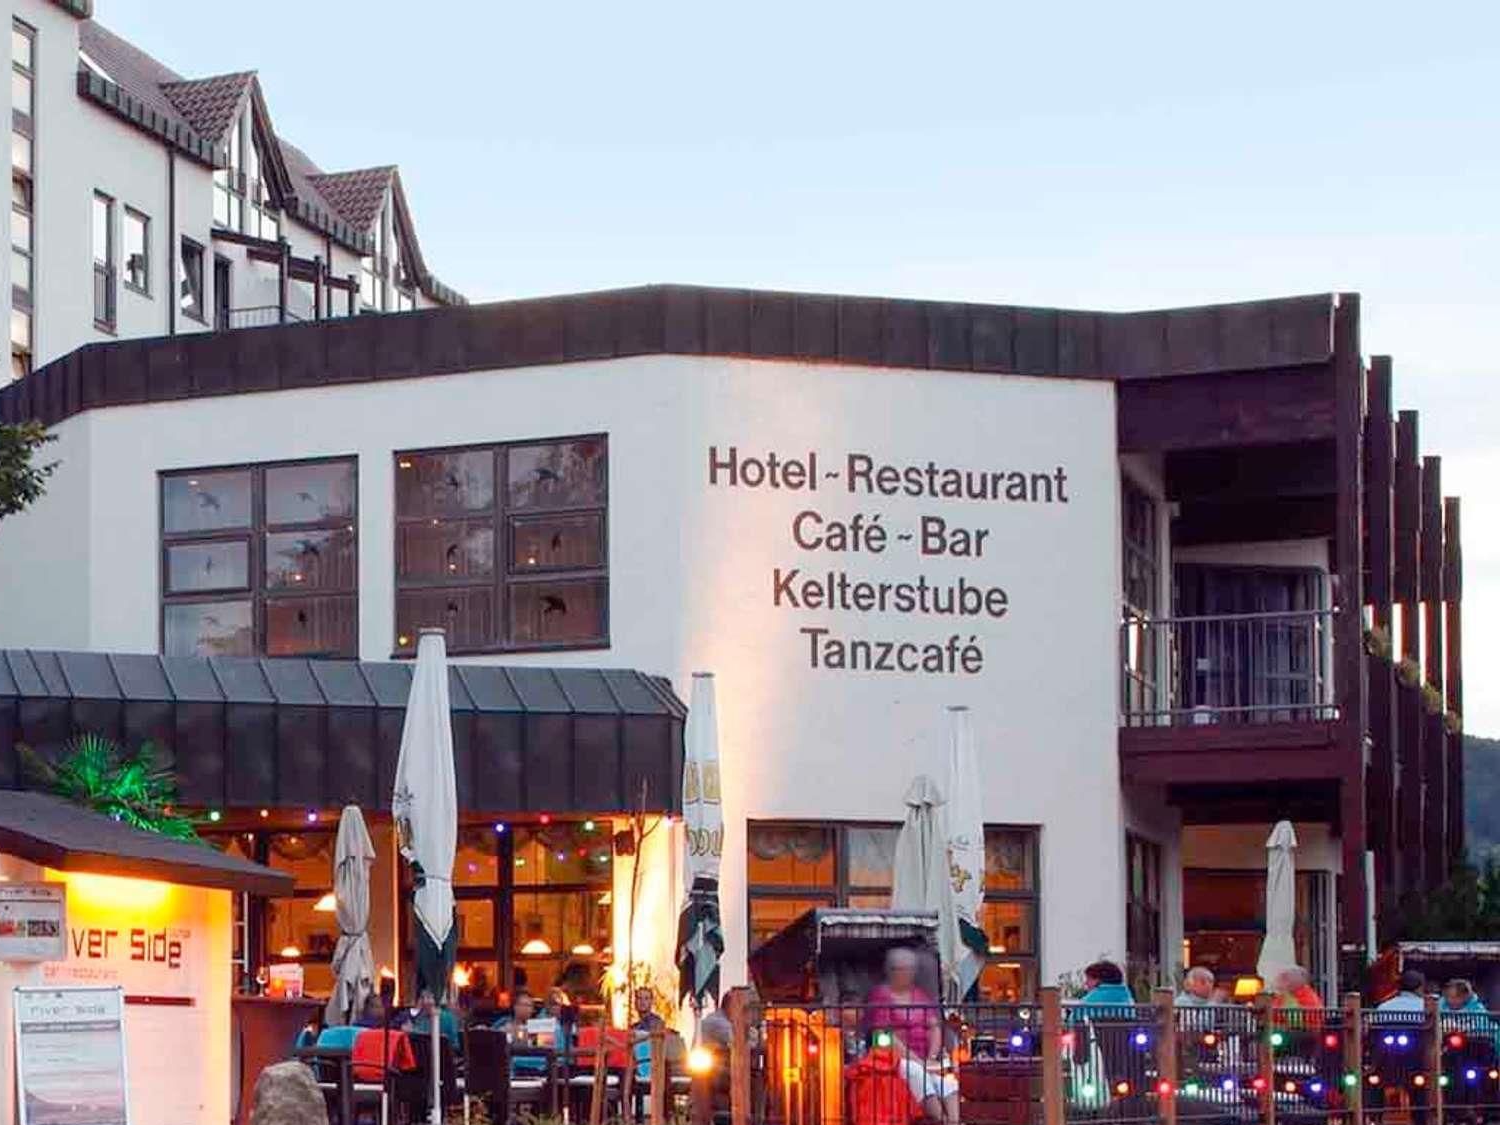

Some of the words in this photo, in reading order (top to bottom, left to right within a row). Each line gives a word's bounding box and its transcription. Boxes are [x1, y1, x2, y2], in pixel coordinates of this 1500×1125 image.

[708, 446, 816, 490] Hotel
[847, 453, 1068, 503] Restaurant
[792, 510, 887, 553] Café
[921, 515, 989, 557] Bar
[773, 568, 1009, 617] Kelterstube
[800, 627, 984, 674] Tanzcafé
[71, 928, 118, 958] ver
